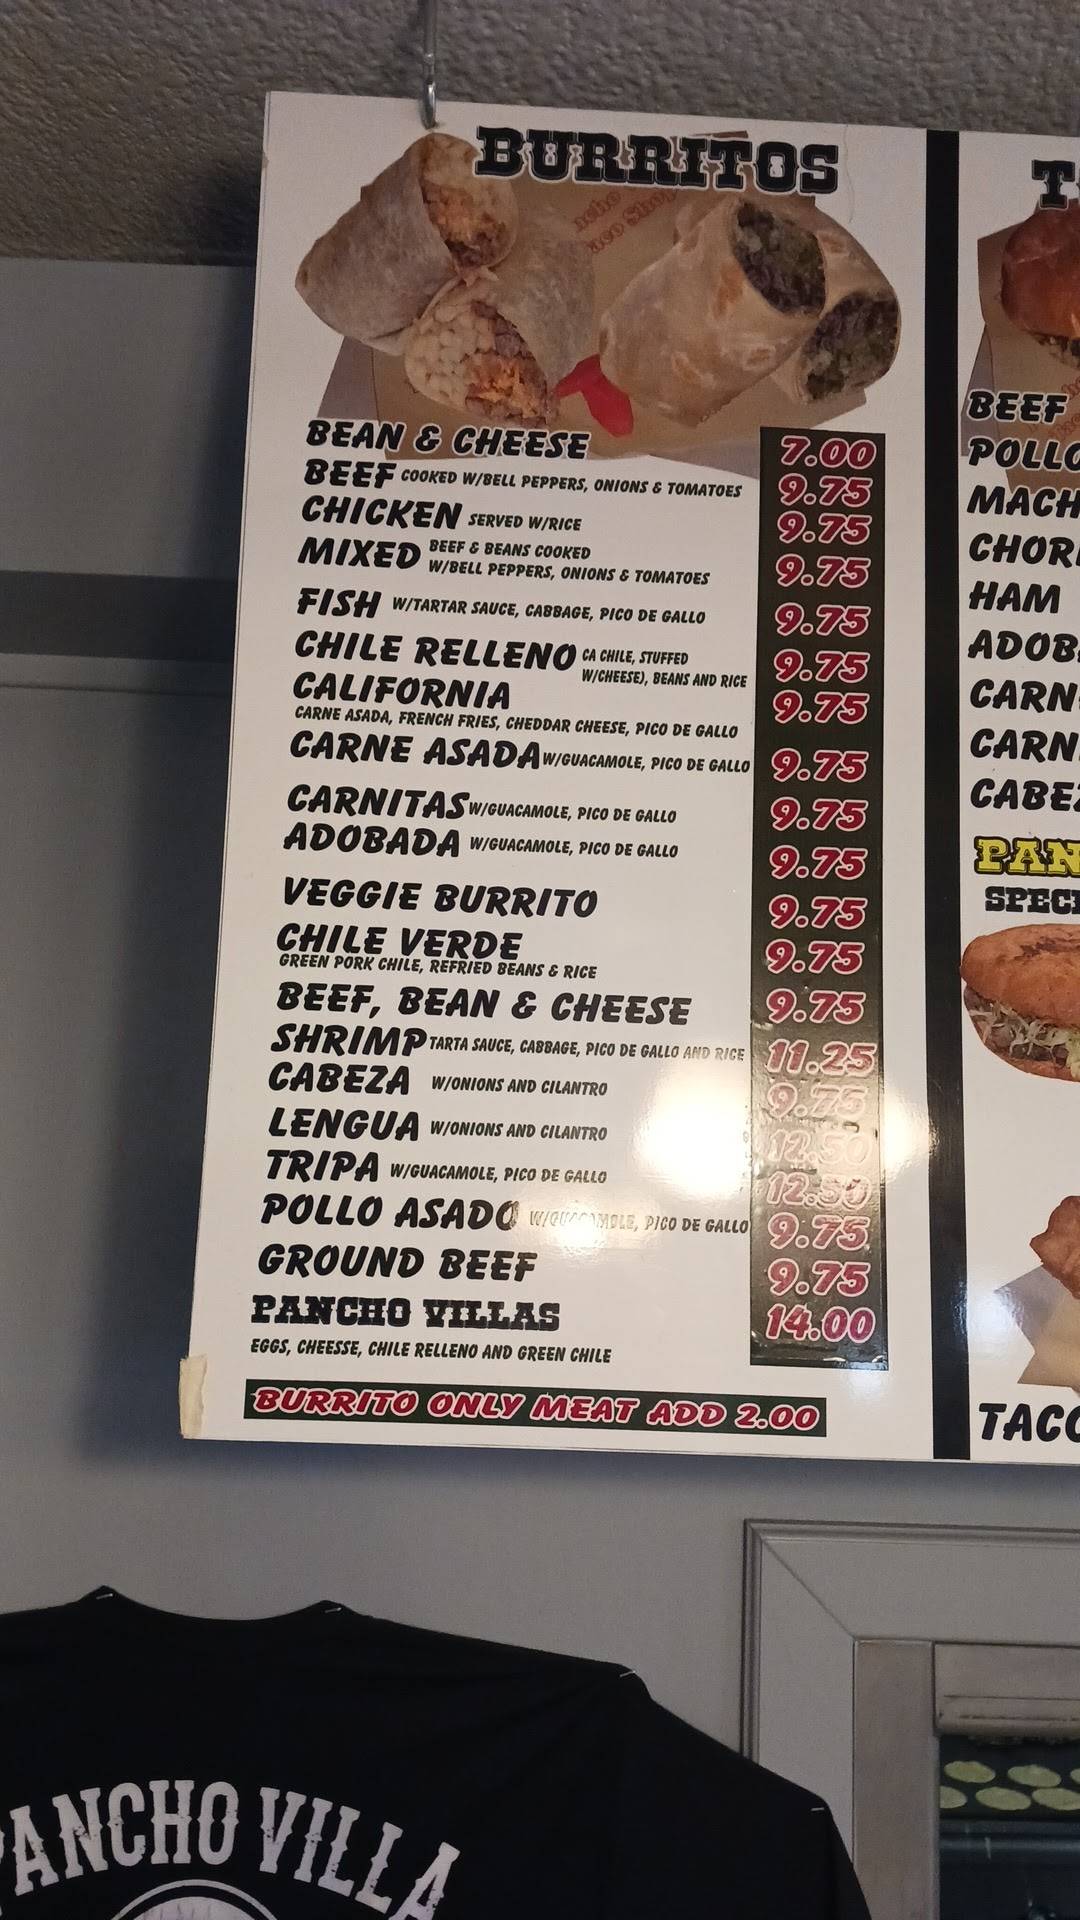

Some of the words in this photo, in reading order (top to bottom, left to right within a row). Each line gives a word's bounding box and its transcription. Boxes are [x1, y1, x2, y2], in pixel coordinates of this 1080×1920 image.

[474, 124, 840, 194] BURRITOS
[1031, 159, 1080, 209] T
[968, 390, 1067, 424] BEEF
[305, 420, 405, 452] BEAN
[414, 424, 441, 454] &
[452, 427, 591, 459] CHEESE
[780, 435, 877, 470] 7.00
[968, 437, 1080, 471] POLLO
[304, 459, 397, 489] BEEF
[401, 469, 457, 484] COOKED
[463, 472, 516, 487] W/BELL
[521, 475, 588, 493] PEPPERS,
[594, 479, 649, 493] ONIONS
[652, 482, 662, 494] &
[668, 482, 742, 498] TOMATOES
[778, 473, 873, 508] 9.75
[302, 495, 463, 529] CHICKEN
[468, 513, 523, 528] SERVED
[529, 516, 582, 531] W/RICE
[967, 484, 1080, 520] MACH
[777, 510, 872, 545] 9.75
[297, 537, 421, 569] MIXED
[429, 539, 466, 553] BEEF
[469, 541, 479, 554] &
[484, 542, 531, 557] BEANS
[535, 545, 591, 560] COOKED
[775, 553, 871, 588] 9.75
[429, 560, 482, 575] W/BELL
[488, 563, 555, 581] PEPPERS,
[561, 567, 616, 581] ONIONS
[619, 569, 629, 582] &
[635, 570, 710, 585] TOMATOES
[297, 588, 382, 618] FISH
[393, 597, 467, 614] W/TARTAR
[471, 601, 519, 618] SAUCE,
[525, 604, 593, 622] CABBAGE,
[600, 607, 633, 621] PICO
[638, 609, 657, 622] DE
[662, 610, 705, 624] GALLO
[969, 581, 1060, 614] HAM
[775, 602, 871, 637] 9.75
[295, 630, 403, 662] CHILE
[414, 637, 576, 671] RELLENO
[582, 648, 596, 661] CA
[600, 649, 635, 665] CHILE,
[639, 651, 688, 665] STUFFED
[967, 628, 1080, 664] ADOB
[582, 669, 648, 686] W/CHEESE),
[653, 672, 690, 685] BEANS
[692, 673, 717, 686] AND
[720, 674, 747, 688] RICE
[774, 648, 870, 683] 9.75
[293, 672, 509, 710] CALIFORNIA
[773, 689, 870, 724] 9.75
[969, 678, 1080, 714] CARN
[295, 706, 341, 720] CARNE
[345, 708, 392, 725] ASADA,
[399, 711, 454, 726] FRENCH
[458, 714, 500, 731] FRIES,
[506, 717, 571, 733] CHEDDAR
[575, 720, 629, 736] CHEESE,
[635, 722, 668, 736] PICO
[673, 723, 691, 736] DE
[696, 724, 738, 738] GALLO
[290, 730, 413, 763] CARNE
[423, 737, 540, 769] ASADA
[543, 752, 645, 771] W/GUACAMOLE,
[651, 757, 682, 770] PICO
[687, 758, 705, 771] DE
[709, 759, 750, 773] GALLO
[969, 727, 1080, 764] CARN
[771, 748, 869, 782] 9.75
[288, 784, 470, 819] CARNITAS
[469, 802, 571, 821] W/GUACAMOLE,
[578, 807, 609, 820] PICO
[613, 808, 631, 821] DE
[635, 809, 676, 823] GALLO
[770, 796, 868, 831] 9.75
[283, 822, 459, 857] ADOBADA
[470, 837, 573, 856] W/GUACAMOLE,
[579, 842, 610, 855] PICO
[615, 843, 633, 856] DE
[637, 844, 678, 858] GALLO
[769, 845, 868, 880] 9.75
[284, 877, 422, 910] VEGGIE
[434, 884, 597, 918] BURRITO
[768, 894, 867, 929] 9.75
[277, 923, 387, 954] CHILE
[401, 928, 523, 960] VERDE
[766, 938, 864, 974] 9.75
[279, 953, 330, 968] GREEN
[334, 955, 375, 971] PORK
[378, 957, 423, 974] CHILE,
[429, 959, 492, 975] REFRIED
[497, 962, 545, 977] BEANS
[548, 964, 558, 977] &
[563, 965, 597, 979] RICE
[277, 981, 380, 1019] BEEF,
[398, 986, 500, 1018] BEAN
[511, 991, 537, 1019] &
[551, 993, 692, 1025] CHEESE
[767, 988, 866, 1024] 9.75
[271, 1023, 427, 1056] SHRIMP
[430, 1036, 468, 1051] TARTA
[472, 1038, 514, 1055] SAUCE,
[520, 1040, 580, 1057] CABBAGE,
[586, 1042, 615, 1056] PICO
[620, 1044, 637, 1057] DE
[641, 1045, 679, 1058] GALLO
[683, 1045, 711, 1061] AND
[714, 1046, 745, 1062] RICE
[766, 1039, 877, 1076] 11.25
[269, 1062, 409, 1095] CABEZA
[432, 1076, 504, 1092] W/ONIONS
[507, 1079, 536, 1093] AND
[541, 1080, 607, 1096] CILANTRO
[767, 1082, 867, 1119] 9.75
[269, 1107, 419, 1141] LENGUA
[431, 1121, 503, 1136] W/ONIONS
[506, 1124, 536, 1137] AND
[541, 1125, 607, 1141] CILANTRO
[267, 1149, 378, 1183] TRIPA
[391, 1163, 497, 1183] W/GUACAMOLE,
[504, 1167, 536, 1181] PICO
[541, 1169, 560, 1182] DE
[565, 1170, 607, 1183] GALLO
[766, 1171, 872, 1209] 12.50
[261, 1193, 383, 1226] POLLO
[394, 1197, 519, 1231] ASADO
[528, 1210, 638, 1232] W/GUMOLE,
[645, 1214, 678, 1231] PICO
[682, 1218, 701, 1231] DE
[705, 1217, 749, 1234] GALLO
[768, 1212, 870, 1250] 9.75
[258, 1244, 424, 1278] GROUND
[439, 1248, 537, 1282] BEEF
[768, 1257, 870, 1296] 9.75
[251, 1295, 411, 1327] PANCHO
[423, 1299, 560, 1331] VILLAS
[766, 1304, 875, 1343] 14.00
[251, 1338, 291, 1356] EGGS,
[297, 1339, 362, 1358] CHEESSE,
[368, 1341, 410, 1356] CHILE
[414, 1343, 478, 1358] RELLENO
[482, 1344, 512, 1359] AND
[518, 1346, 566, 1361] GREEN
[570, 1347, 611, 1363] CHILE
[253, 1386, 421, 1416] BURRITO
[428, 1391, 524, 1419] ONLY
[529, 1394, 641, 1423] MEAT
[646, 1401, 727, 1428] ADD
[736, 1404, 821, 1432] 2.00
[0, 1779, 240, 1896] ANCHO
[259, 1786, 461, 1920] VILLA
